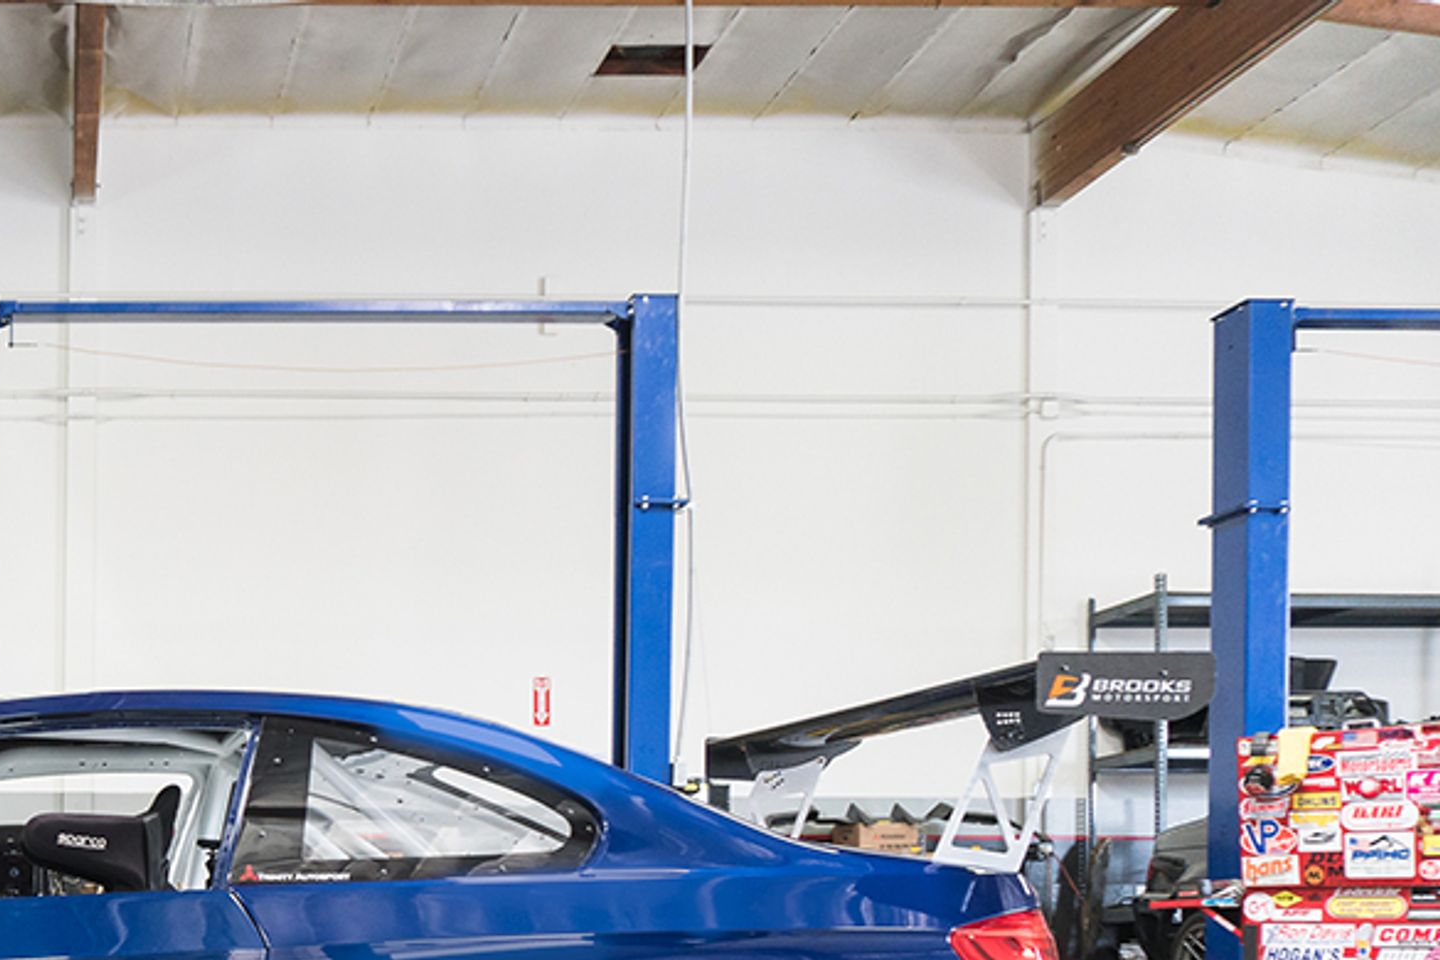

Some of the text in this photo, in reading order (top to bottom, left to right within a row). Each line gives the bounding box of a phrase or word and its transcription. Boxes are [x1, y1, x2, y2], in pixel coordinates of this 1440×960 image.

[1091, 679, 1192, 693] BROOKS
[1091, 694, 1190, 703] MOTORSPORT
[1245, 819, 1279, 854] VP
